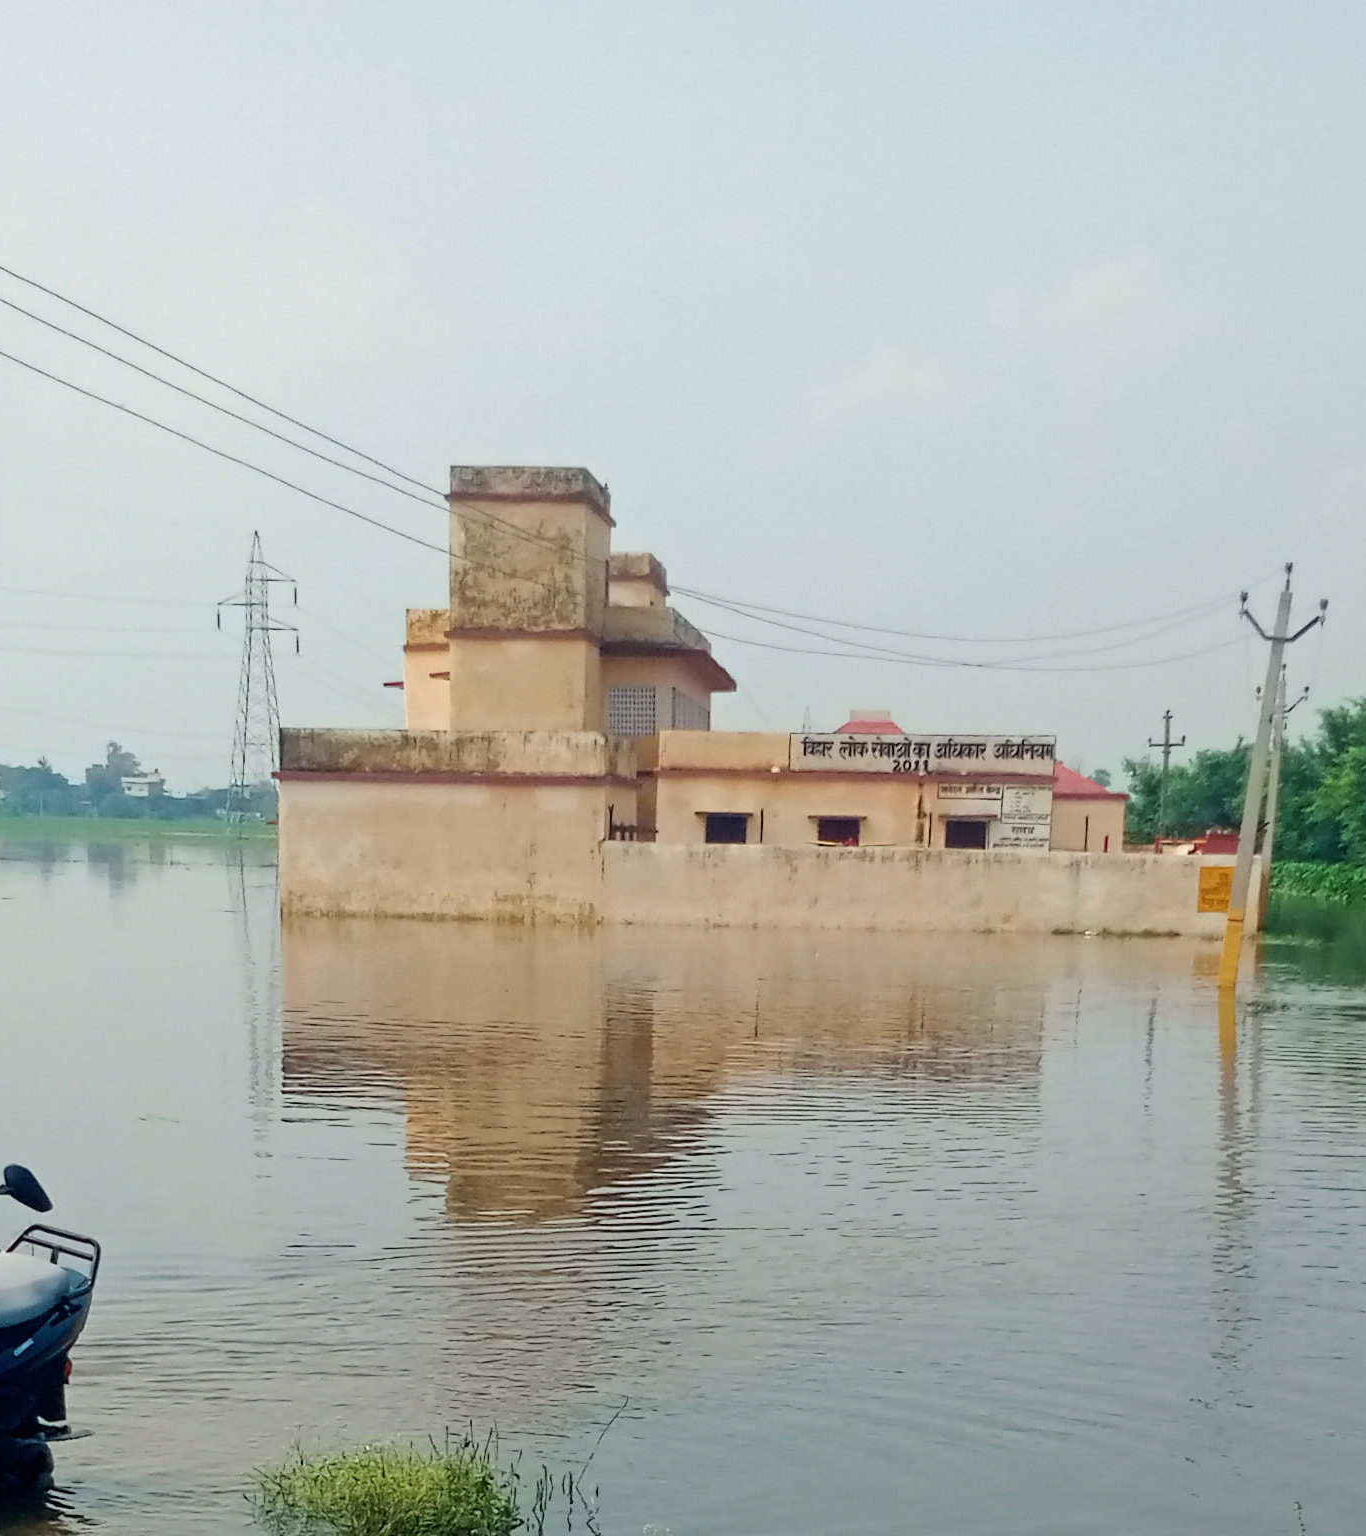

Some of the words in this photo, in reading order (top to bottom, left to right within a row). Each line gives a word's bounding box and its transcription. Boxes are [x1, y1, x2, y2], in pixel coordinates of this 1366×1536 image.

[839, 736, 868, 760] लोक
[913, 742, 931, 759] का
[935, 738, 986, 760] अधिकार
[993, 739, 1055, 760] अधिनियम
[892, 760, 931, 774] 2011
